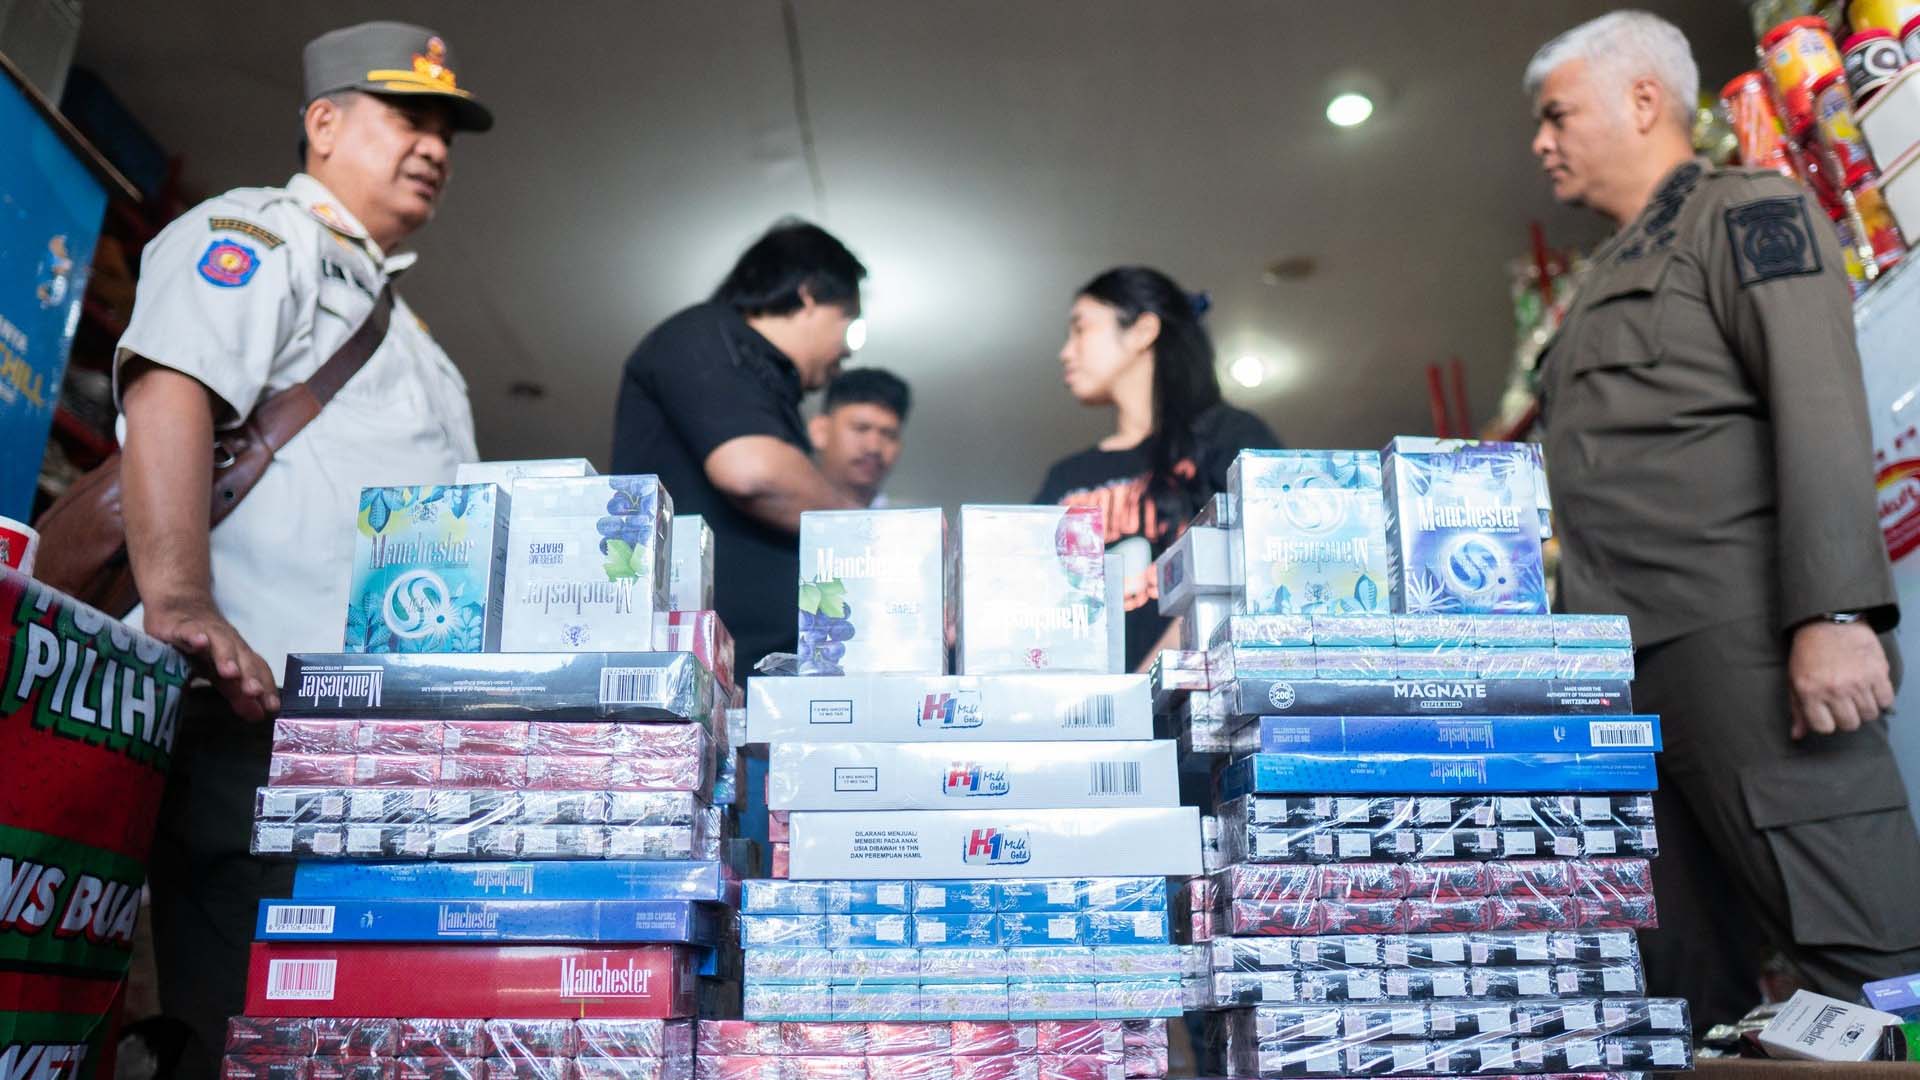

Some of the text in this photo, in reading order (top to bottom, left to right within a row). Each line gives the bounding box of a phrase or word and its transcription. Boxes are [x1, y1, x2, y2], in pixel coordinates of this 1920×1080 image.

[1418, 496, 1522, 532] Manchester
[370, 531, 474, 569] Manchester
[529, 543, 565, 553] GRAPES
[1264, 536, 1369, 575] Manchester
[521, 578, 633, 615] Manchester
[299, 672, 384, 707] Manchester
[1275, 691, 1290, 700] 200
[1393, 684, 1487, 698] MAGNATE
[922, 693, 958, 724] H1
[957, 703, 979, 714] Mild
[1437, 724, 1494, 749] Manchester
[983, 771, 1005, 781] Mild
[1430, 760, 1487, 784] Manchester
[989, 781, 1006, 791] Gold
[968, 828, 1003, 860] H1
[1004, 838, 1025, 850] Mild
[1010, 850, 1027, 859] Gold
[473, 868, 534, 894] Manchester
[438, 904, 499, 932] Manchester
[560, 957, 652, 997] Manchester
[1802, 1005, 1848, 1046] Manchester
